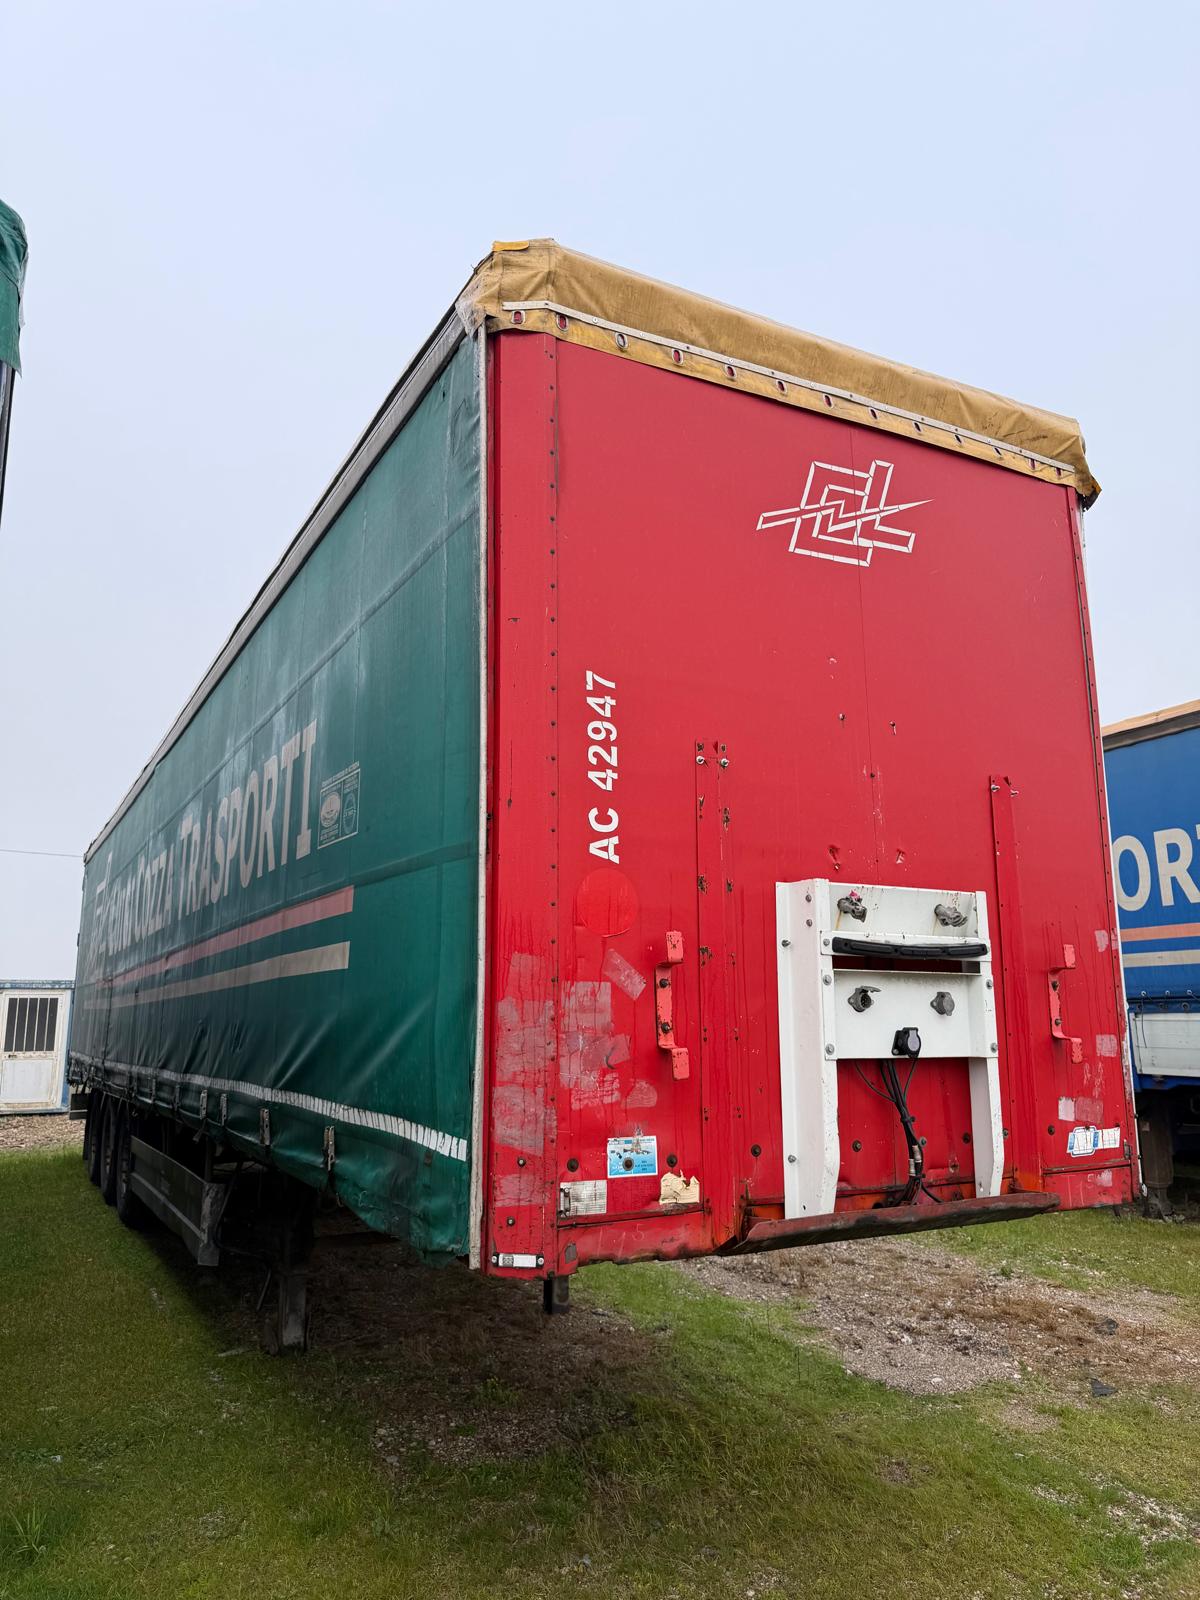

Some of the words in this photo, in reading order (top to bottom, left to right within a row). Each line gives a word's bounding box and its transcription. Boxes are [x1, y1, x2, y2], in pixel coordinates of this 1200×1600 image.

[585, 670, 618, 792] 42947
[134, 843, 174, 943] COZZA
[176, 718, 317, 921] TRASPORTI
[588, 807, 620, 865] AC
[1112, 823, 1200, 912] OR
